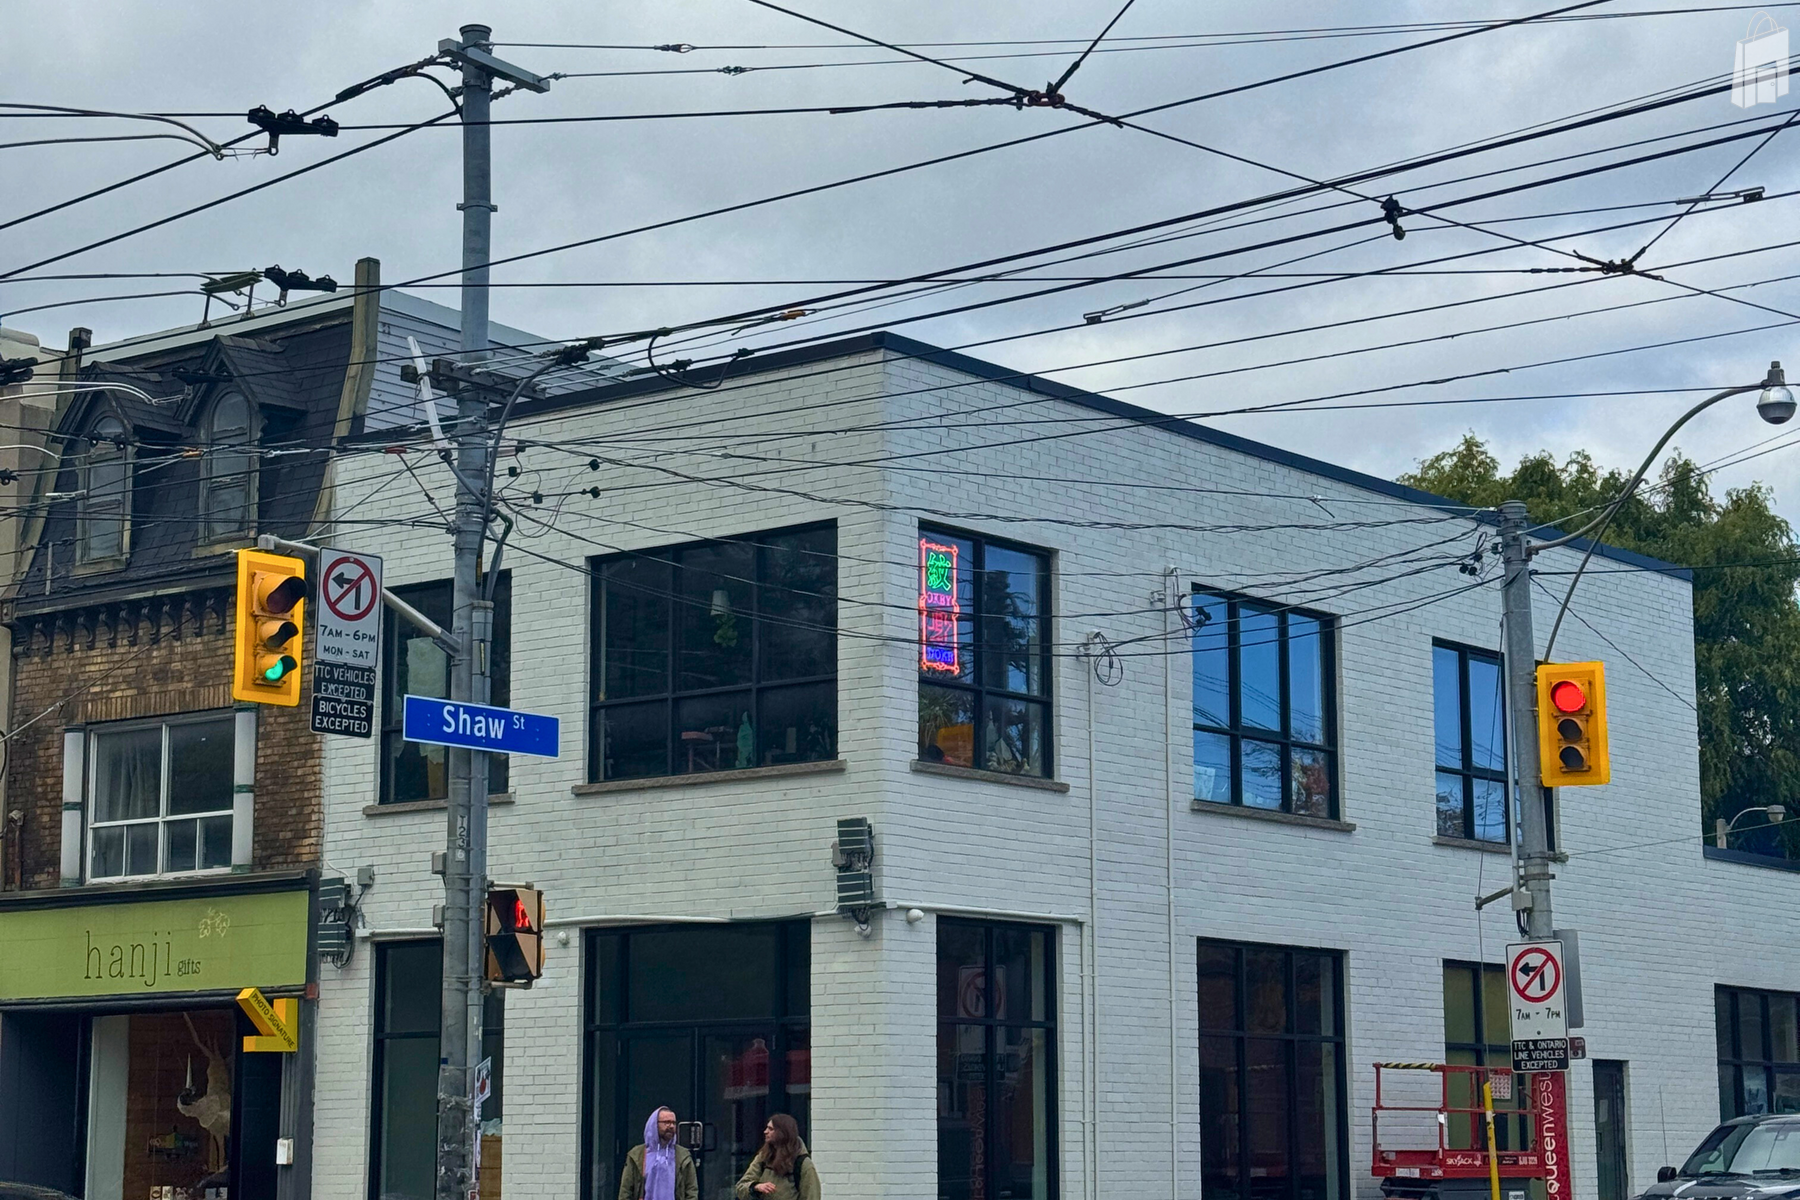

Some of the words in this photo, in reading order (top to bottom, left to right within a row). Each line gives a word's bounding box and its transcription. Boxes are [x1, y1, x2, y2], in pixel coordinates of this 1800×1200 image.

[320, 624, 343, 638] 7AM
[353, 630, 376, 643] 6PM
[323, 645, 343, 656] MON
[352, 649, 370, 660] SAT
[314, 665, 331, 679] TTC
[333, 667, 375, 685] VEHICLES
[321, 682, 367, 700] EXCEPTED
[319, 700, 367, 718] BICYCLES
[315, 715, 369, 733] EXCEPTED
[443, 705, 505, 740] Shaw
[513, 714, 525, 730] St
[84, 930, 172, 987] hanji
[177, 958, 201, 977] gifts
[252, 993, 270, 1016] PHOTO
[268, 1013, 295, 1049] SIGNATURE
[1516, 1008, 1531, 1021] 7AM
[1545, 1007, 1561, 1020] 7PM
[1513, 1041, 1526, 1051] TTC
[1528, 1041, 1535, 1050] &
[1537, 1040, 1567, 1049] ONTARIO
[1513, 1051, 1530, 1061] LINE
[1530, 1050, 1565, 1060] VEHICLES
[1521, 1060, 1559, 1070] EXCEPTED
